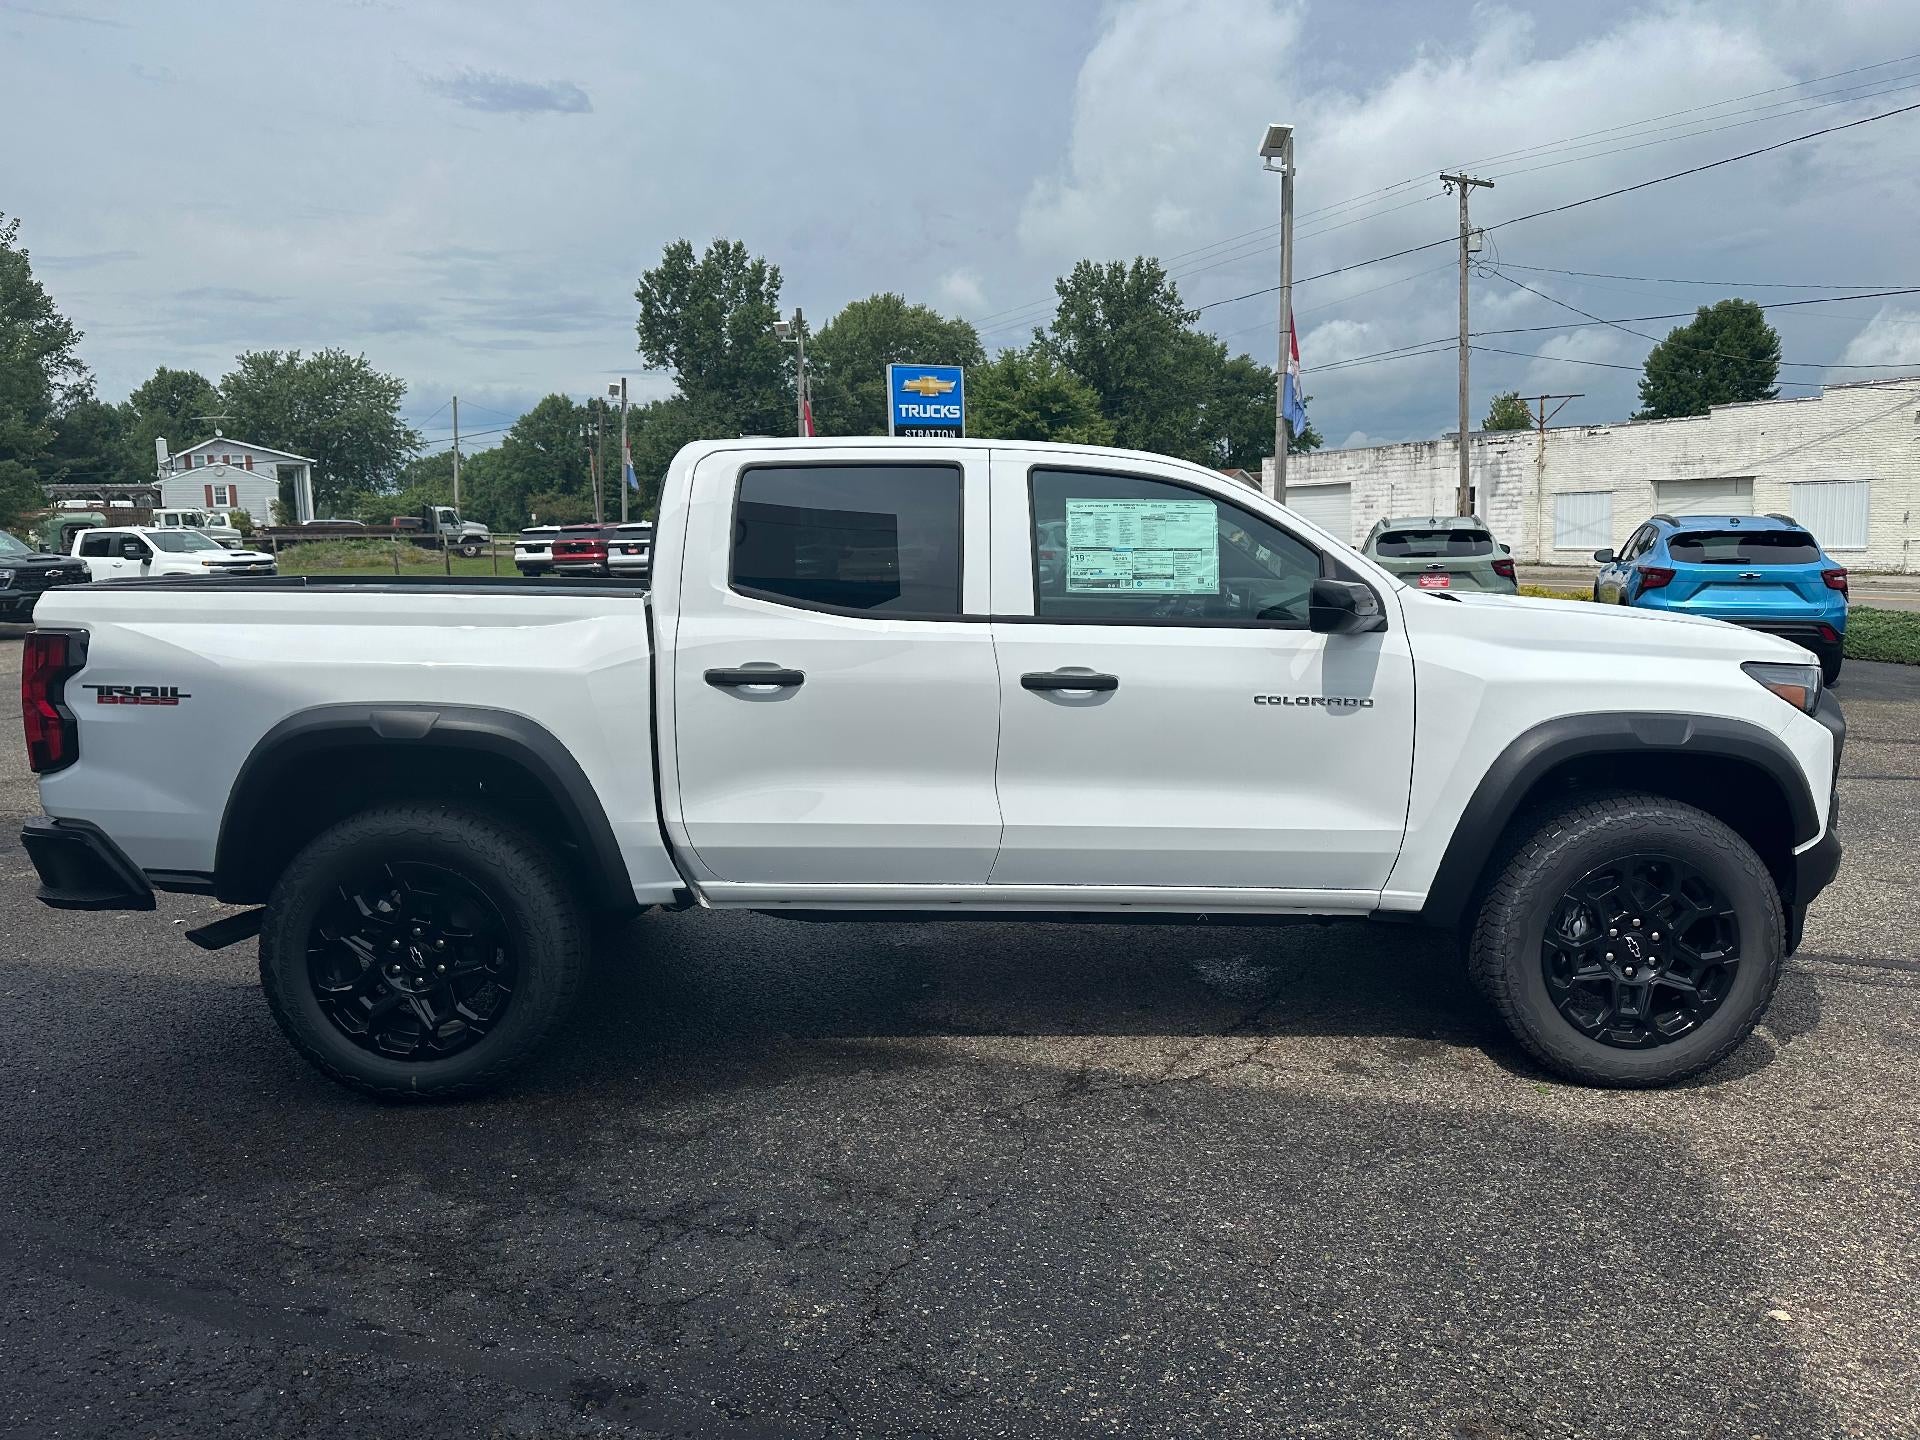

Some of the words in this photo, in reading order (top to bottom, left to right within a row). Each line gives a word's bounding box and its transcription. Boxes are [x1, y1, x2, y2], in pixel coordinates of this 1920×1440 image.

[899, 404, 960, 418] TRUCKS
[905, 430, 956, 438] STRATTON
[82, 685, 191, 698] TRAIL
[97, 695, 179, 706] BOSS
[1253, 695, 1374, 708] COLORADO
